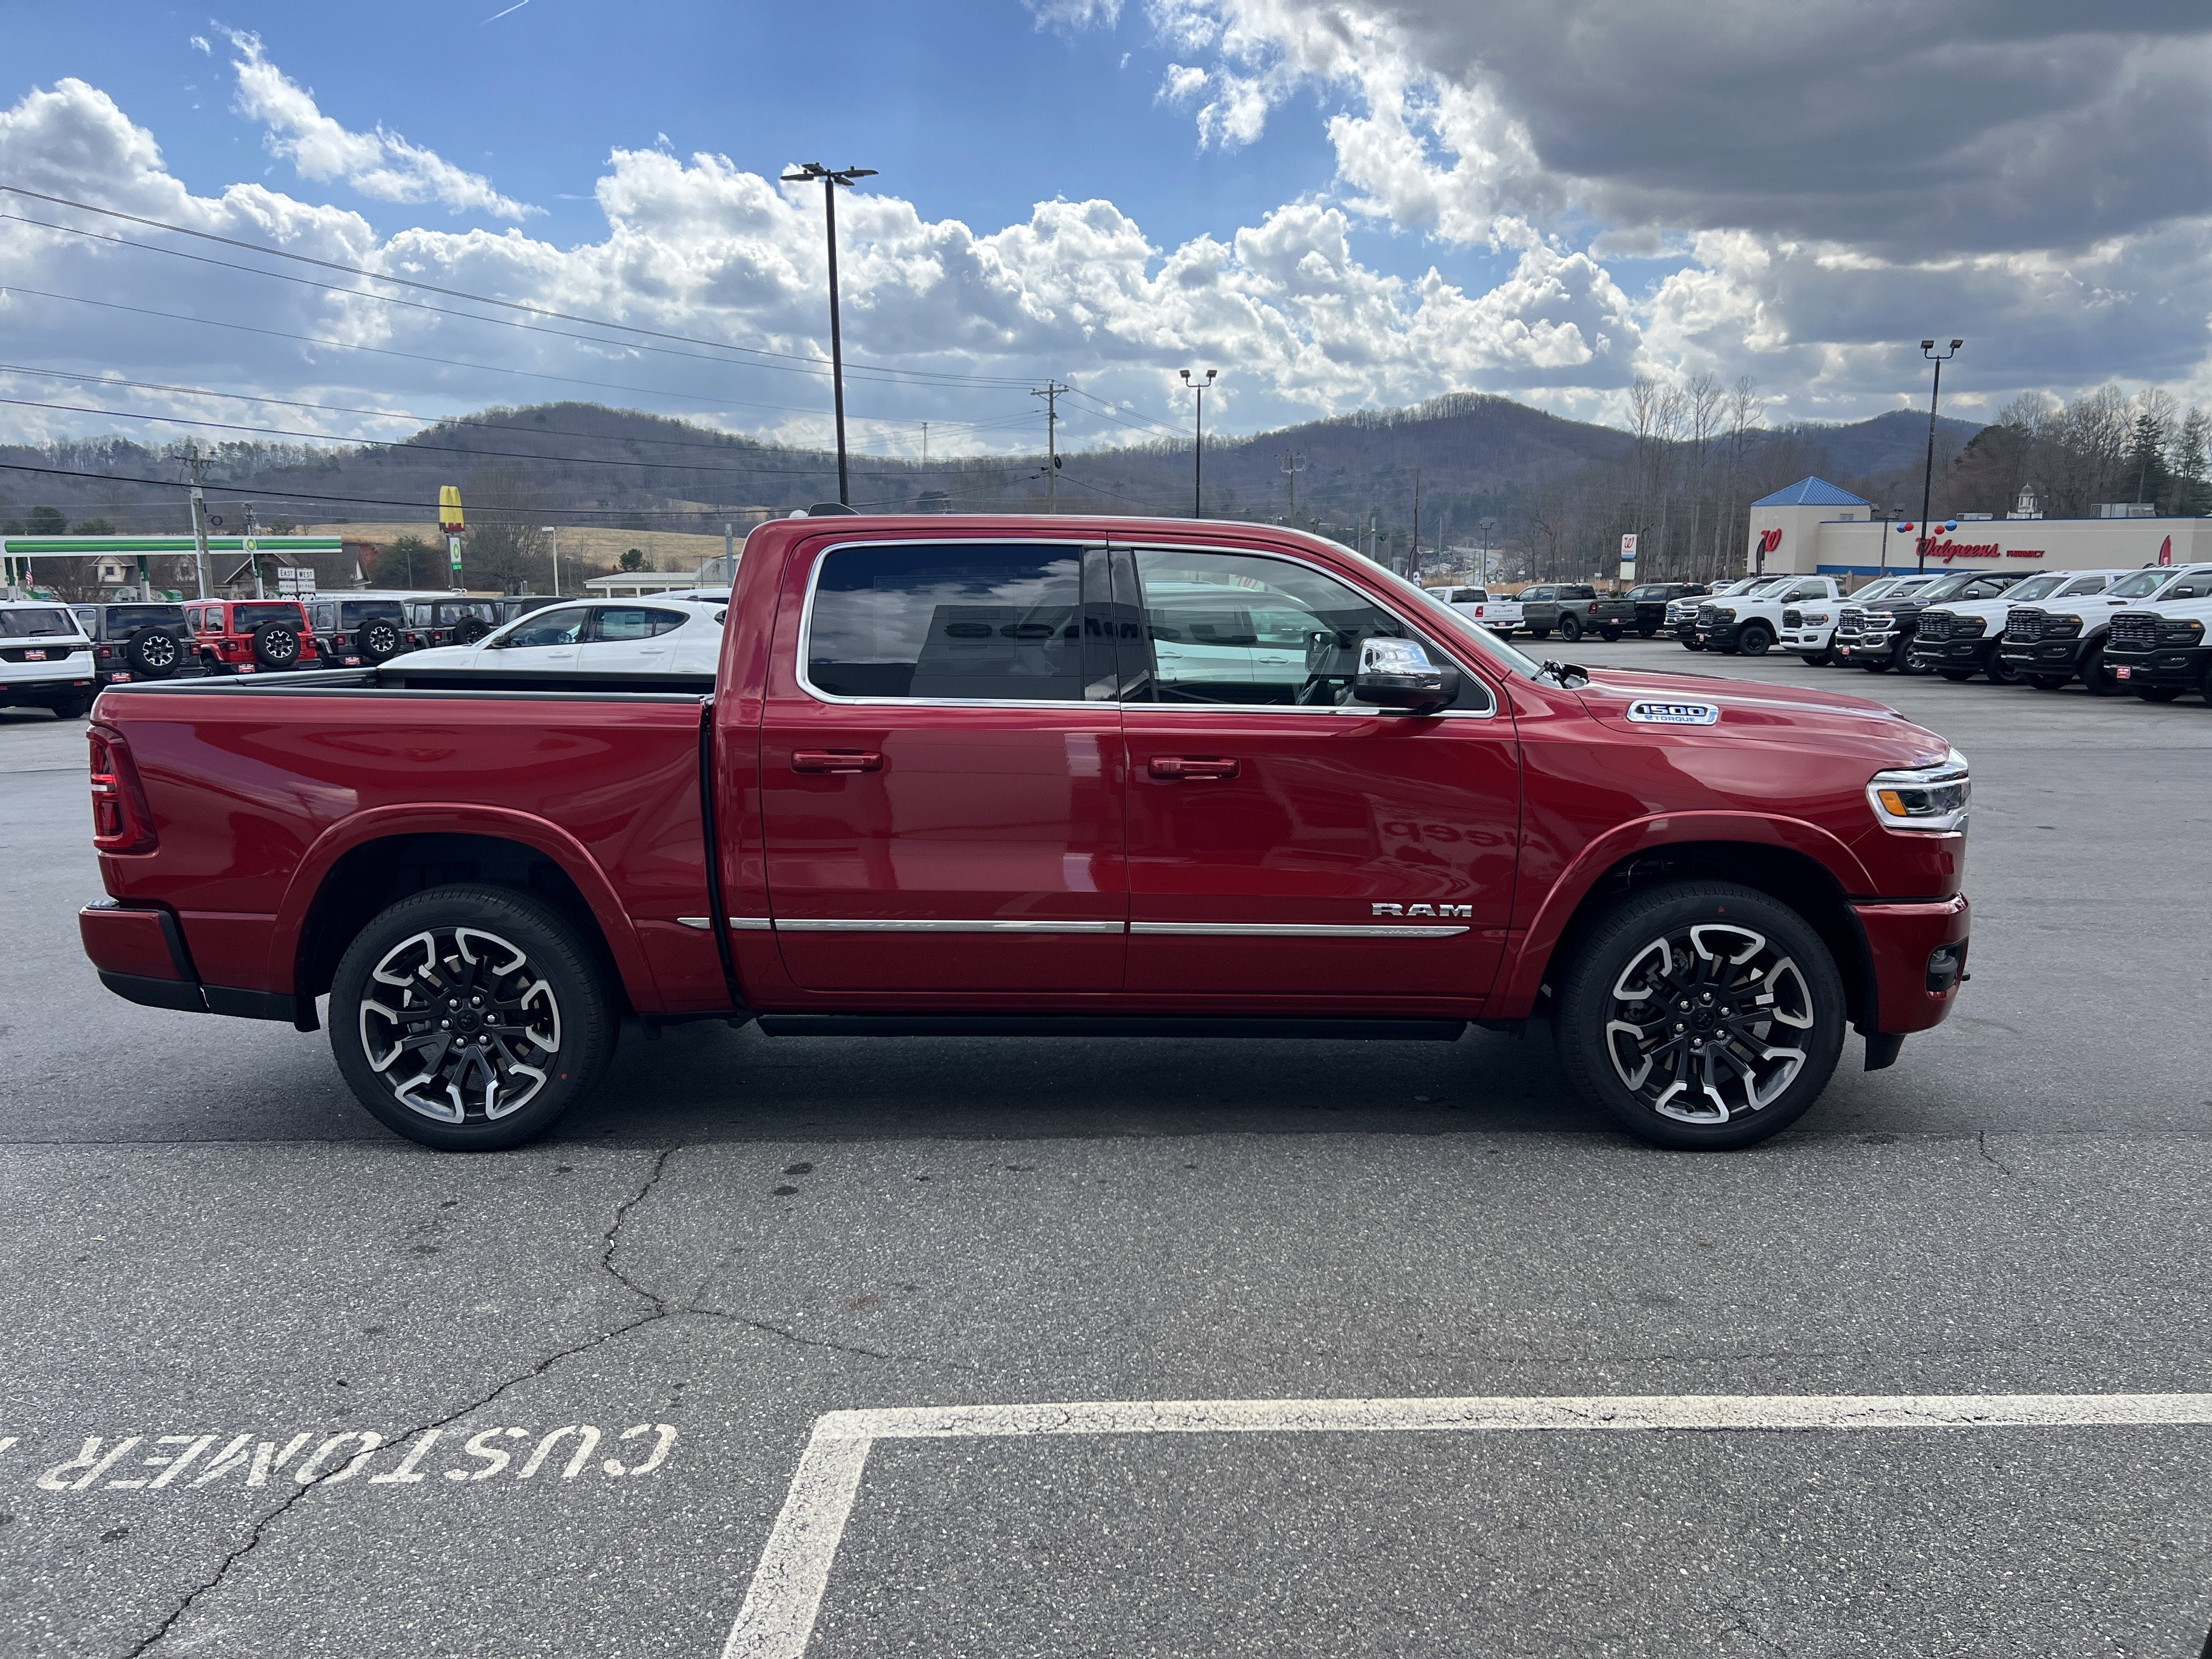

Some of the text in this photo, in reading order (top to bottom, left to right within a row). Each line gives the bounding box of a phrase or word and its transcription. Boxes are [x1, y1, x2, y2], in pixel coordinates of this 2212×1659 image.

[1624, 537, 1634, 549] W
[1760, 528, 1782, 551] W
[1916, 537, 2045, 563] Walgreens PHARMACY
[1640, 706, 1706, 716] 1500
[1372, 903, 1472, 917] RAM
[36, 1424, 678, 1489] CUSTOMER
